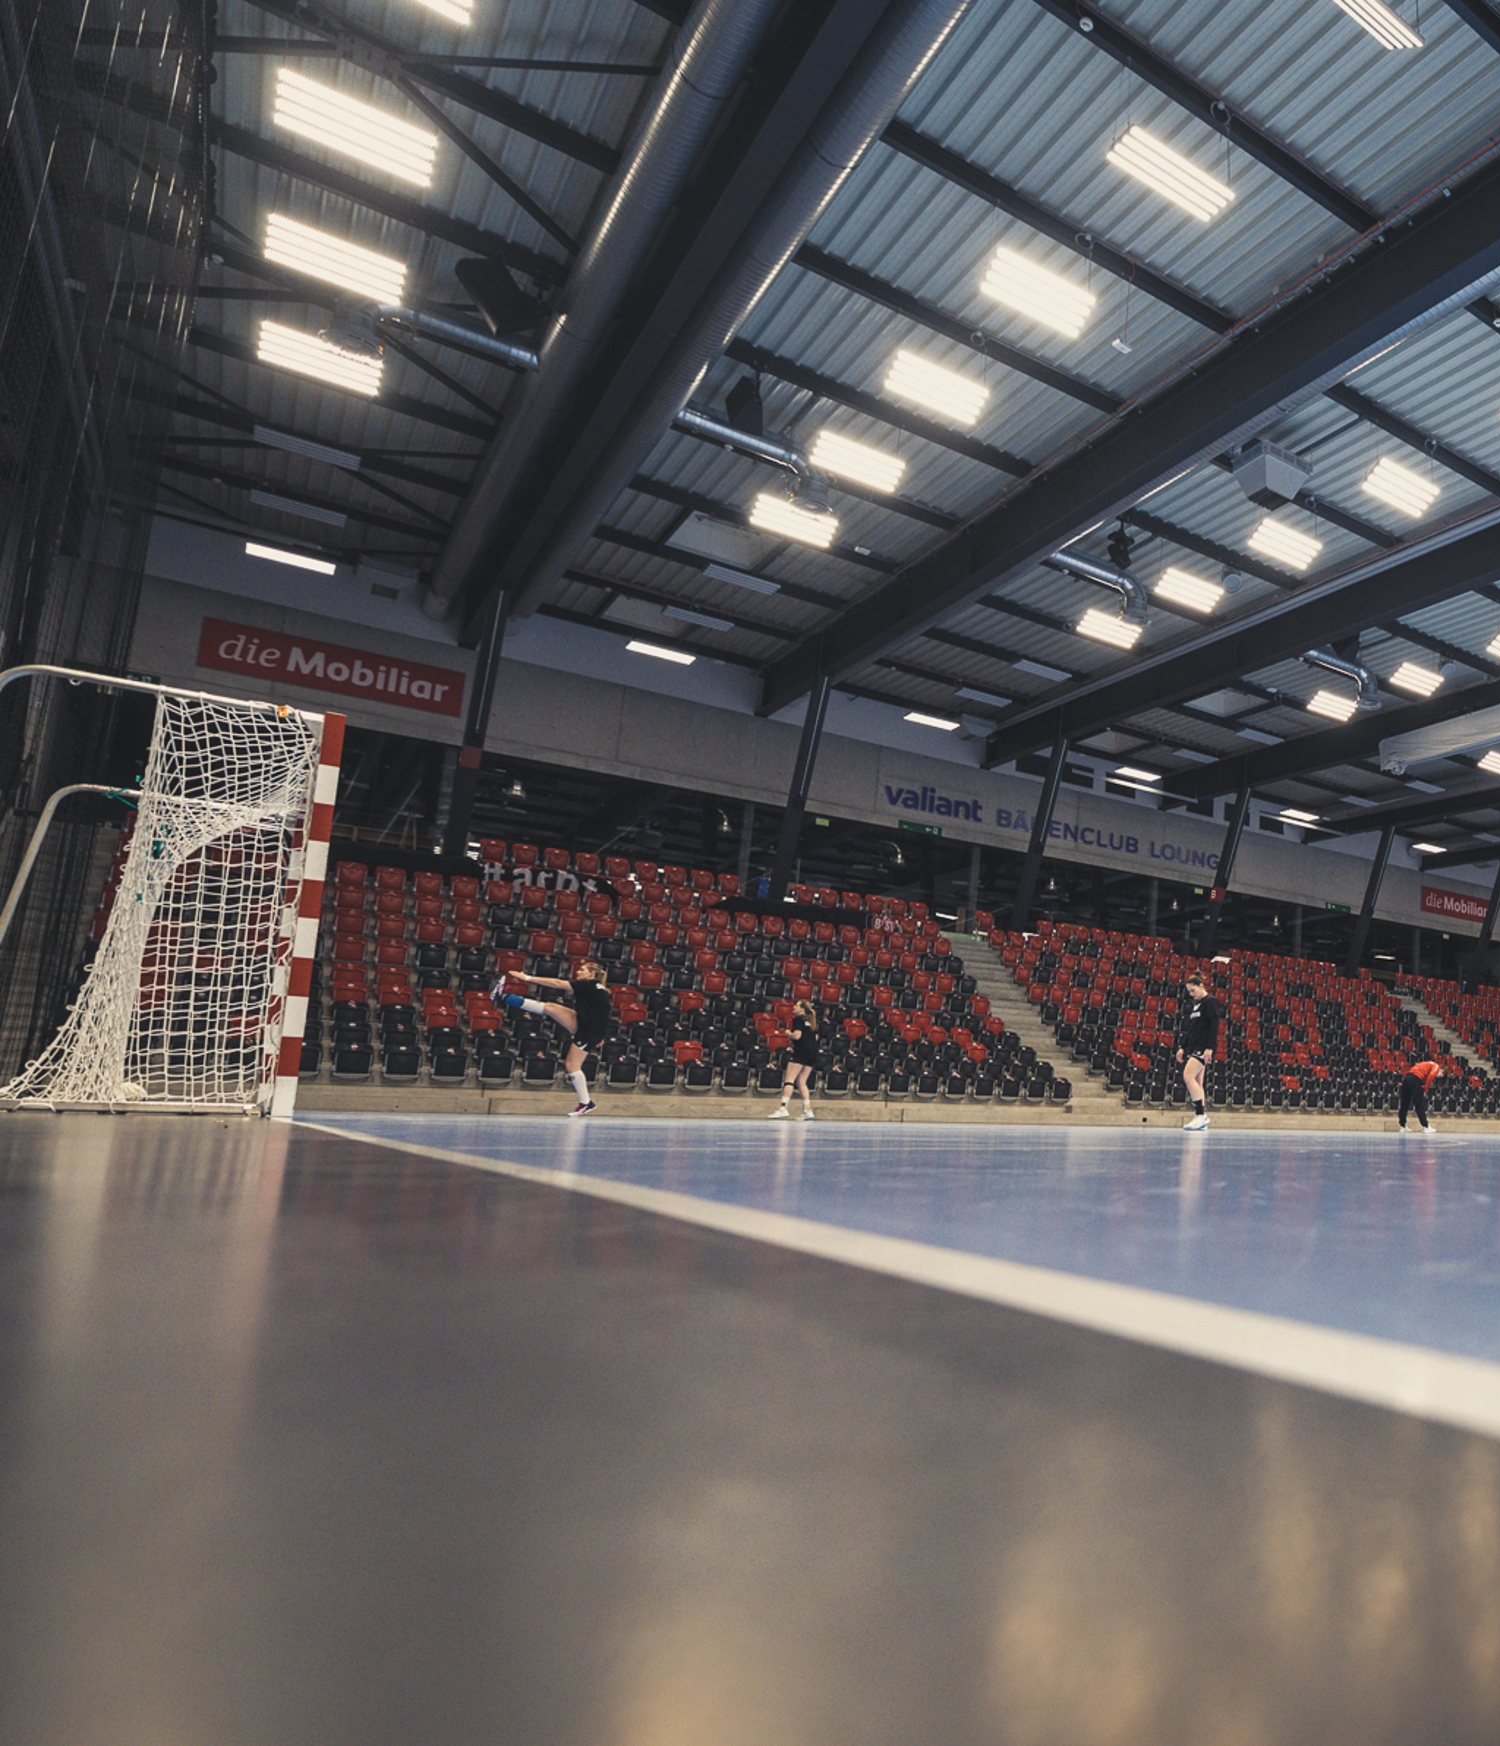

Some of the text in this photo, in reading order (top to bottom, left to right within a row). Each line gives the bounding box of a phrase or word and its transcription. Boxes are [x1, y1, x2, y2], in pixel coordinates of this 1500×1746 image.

[218, 634, 450, 702] die Mobiliar
[884, 785, 1220, 870] valiant BÄENCLUB LOUNG
[1425, 892, 1488, 918] die Mobiliar
